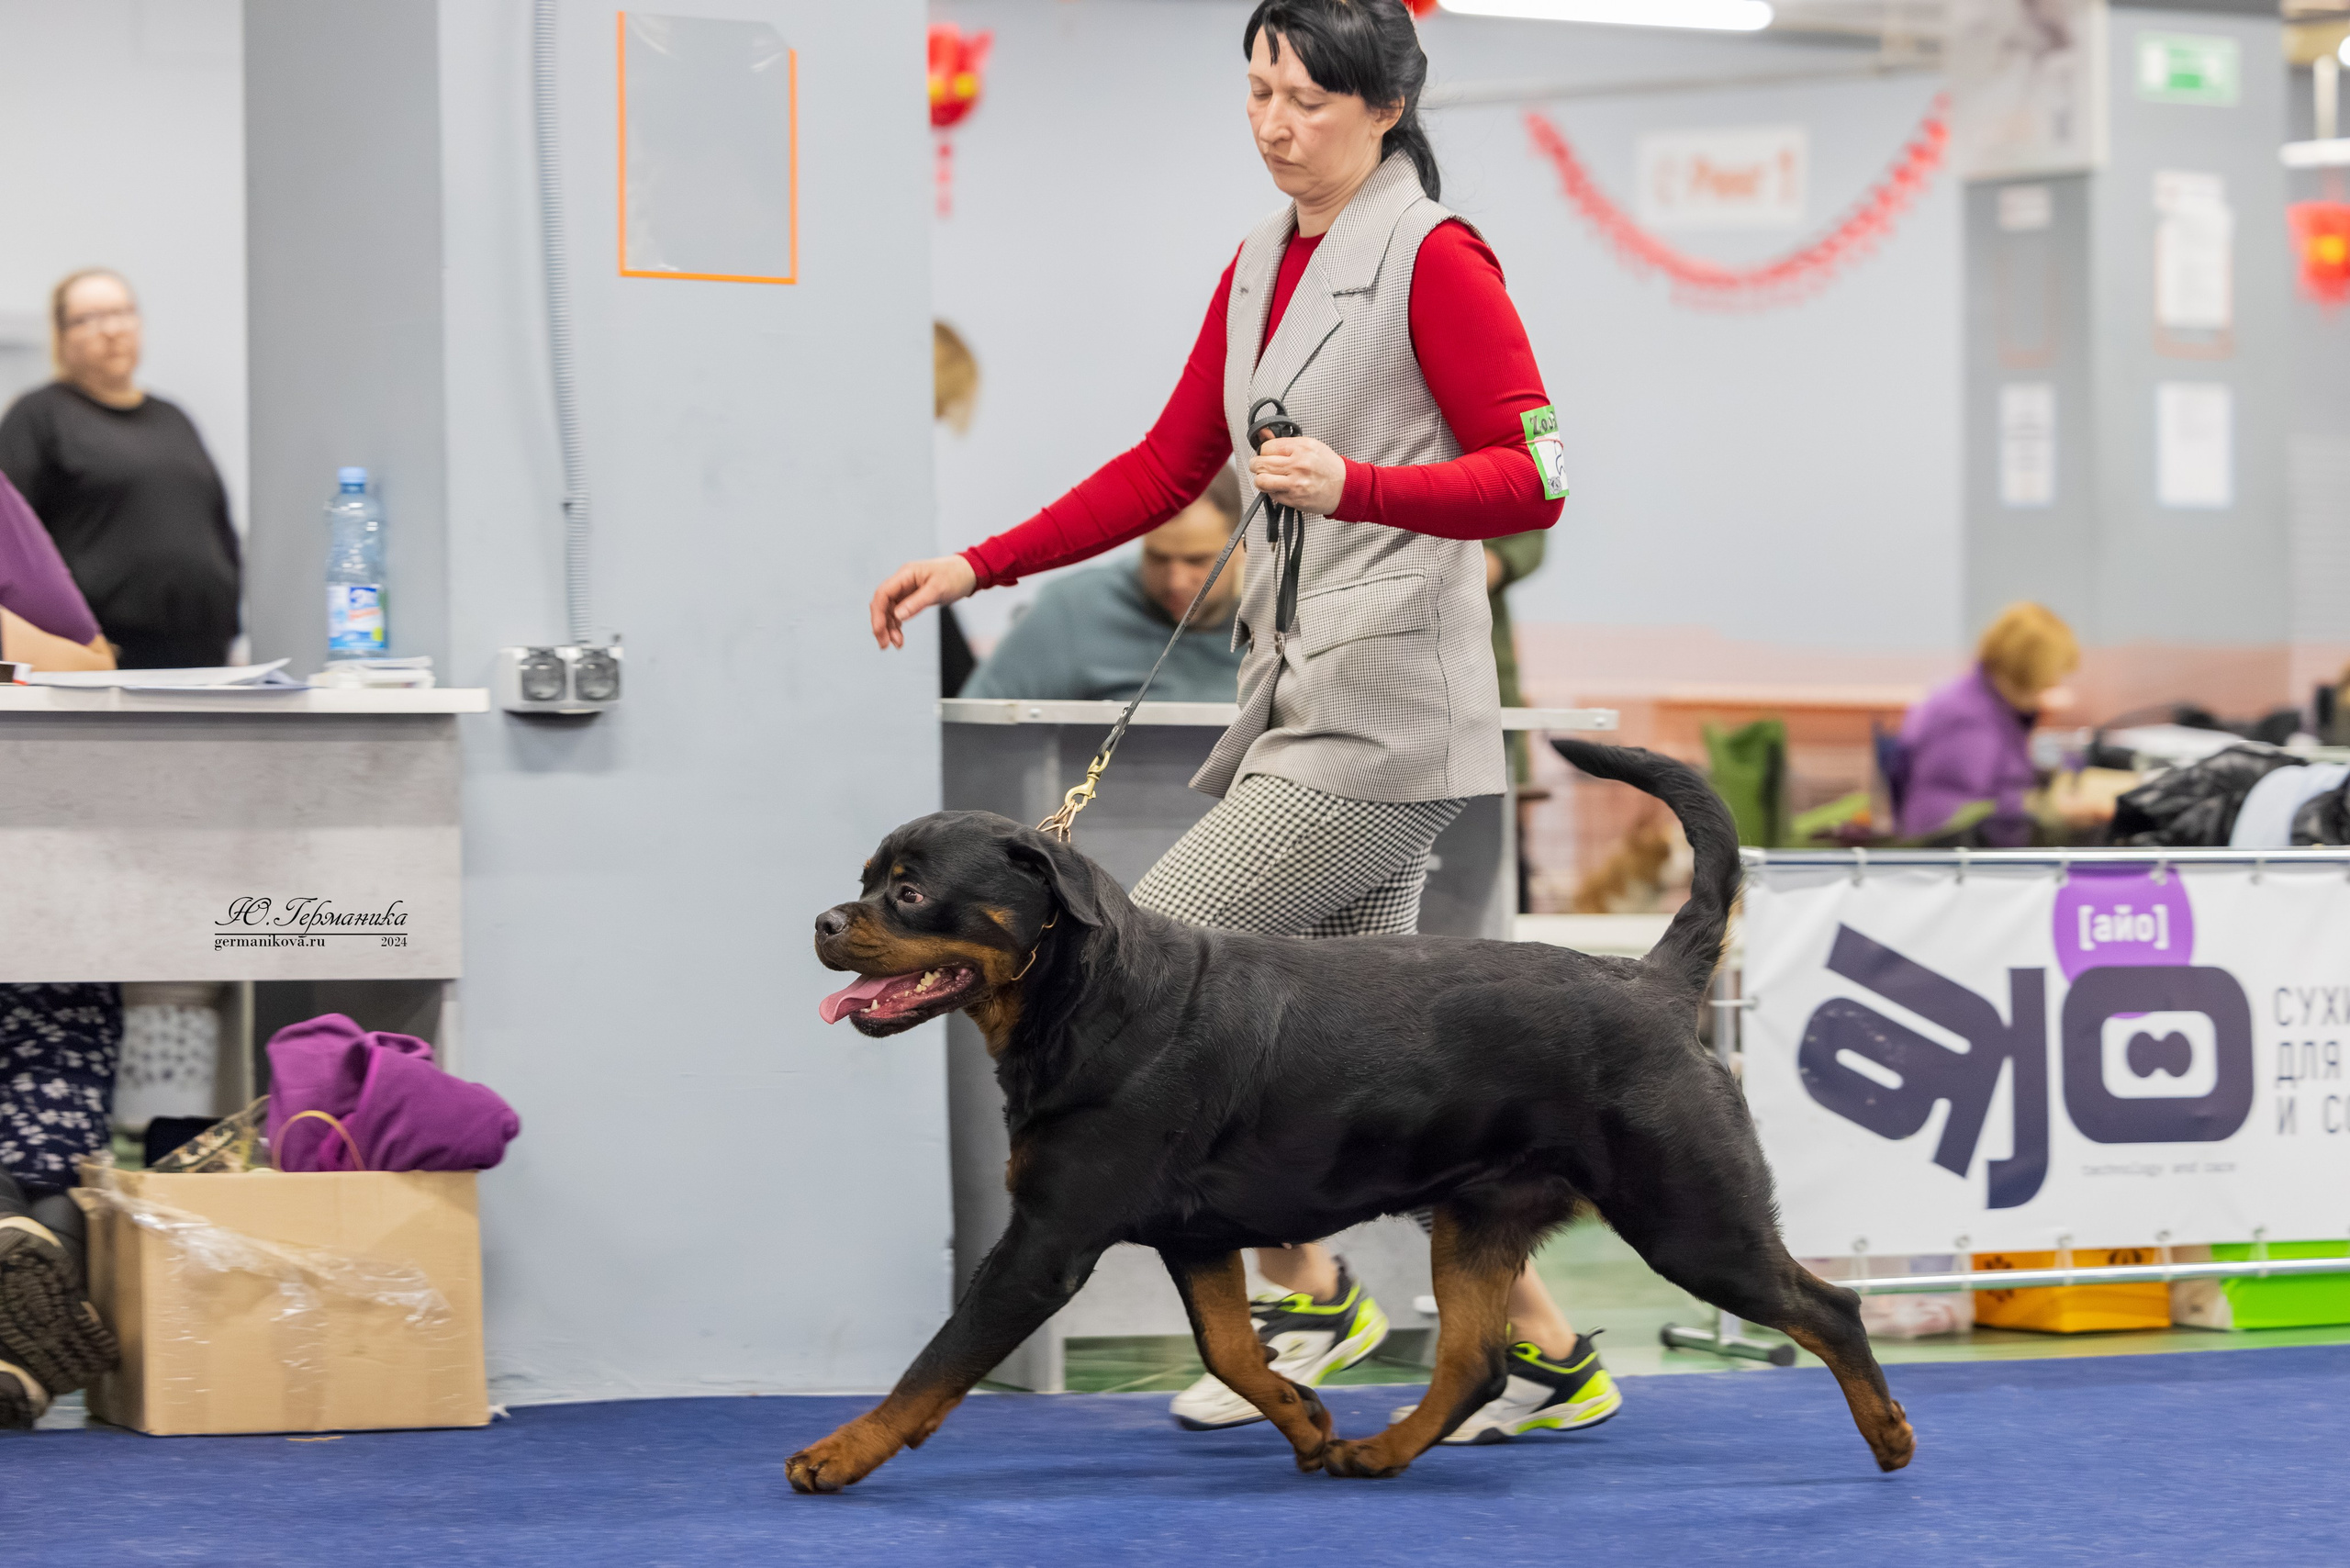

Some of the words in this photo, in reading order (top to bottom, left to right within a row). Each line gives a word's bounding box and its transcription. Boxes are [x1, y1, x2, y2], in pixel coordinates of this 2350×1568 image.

[2275, 1040, 2340, 1089] ДЛЯ
[2277, 1096, 2296, 1135] И
[2323, 1094, 2350, 1134] С
